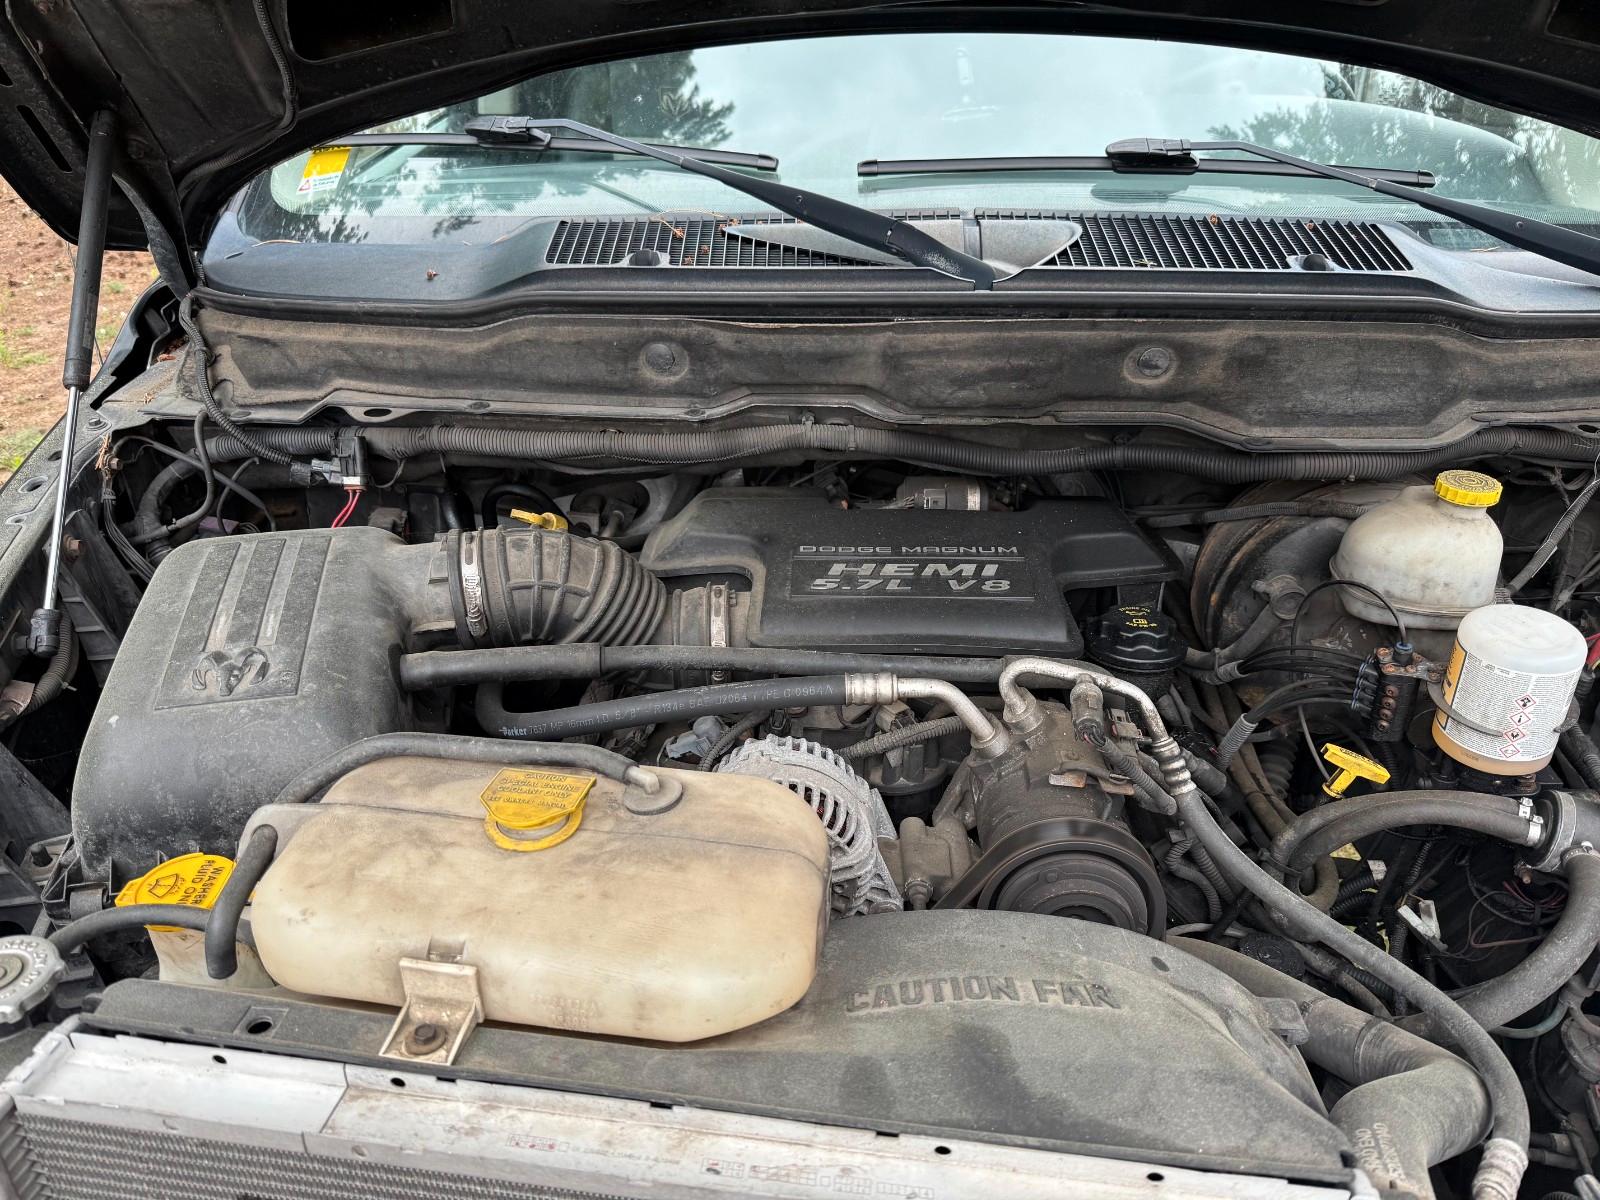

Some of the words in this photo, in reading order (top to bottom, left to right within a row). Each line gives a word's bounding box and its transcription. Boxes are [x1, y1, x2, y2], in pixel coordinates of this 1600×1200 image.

[799, 545, 892, 553] DODGE
[827, 563, 999, 576] HEMI
[810, 578, 913, 590] 5.7L
[947, 579, 1011, 592] V8
[192, 866, 225, 905] WASHER
[846, 976, 1020, 1012] CAUTION
